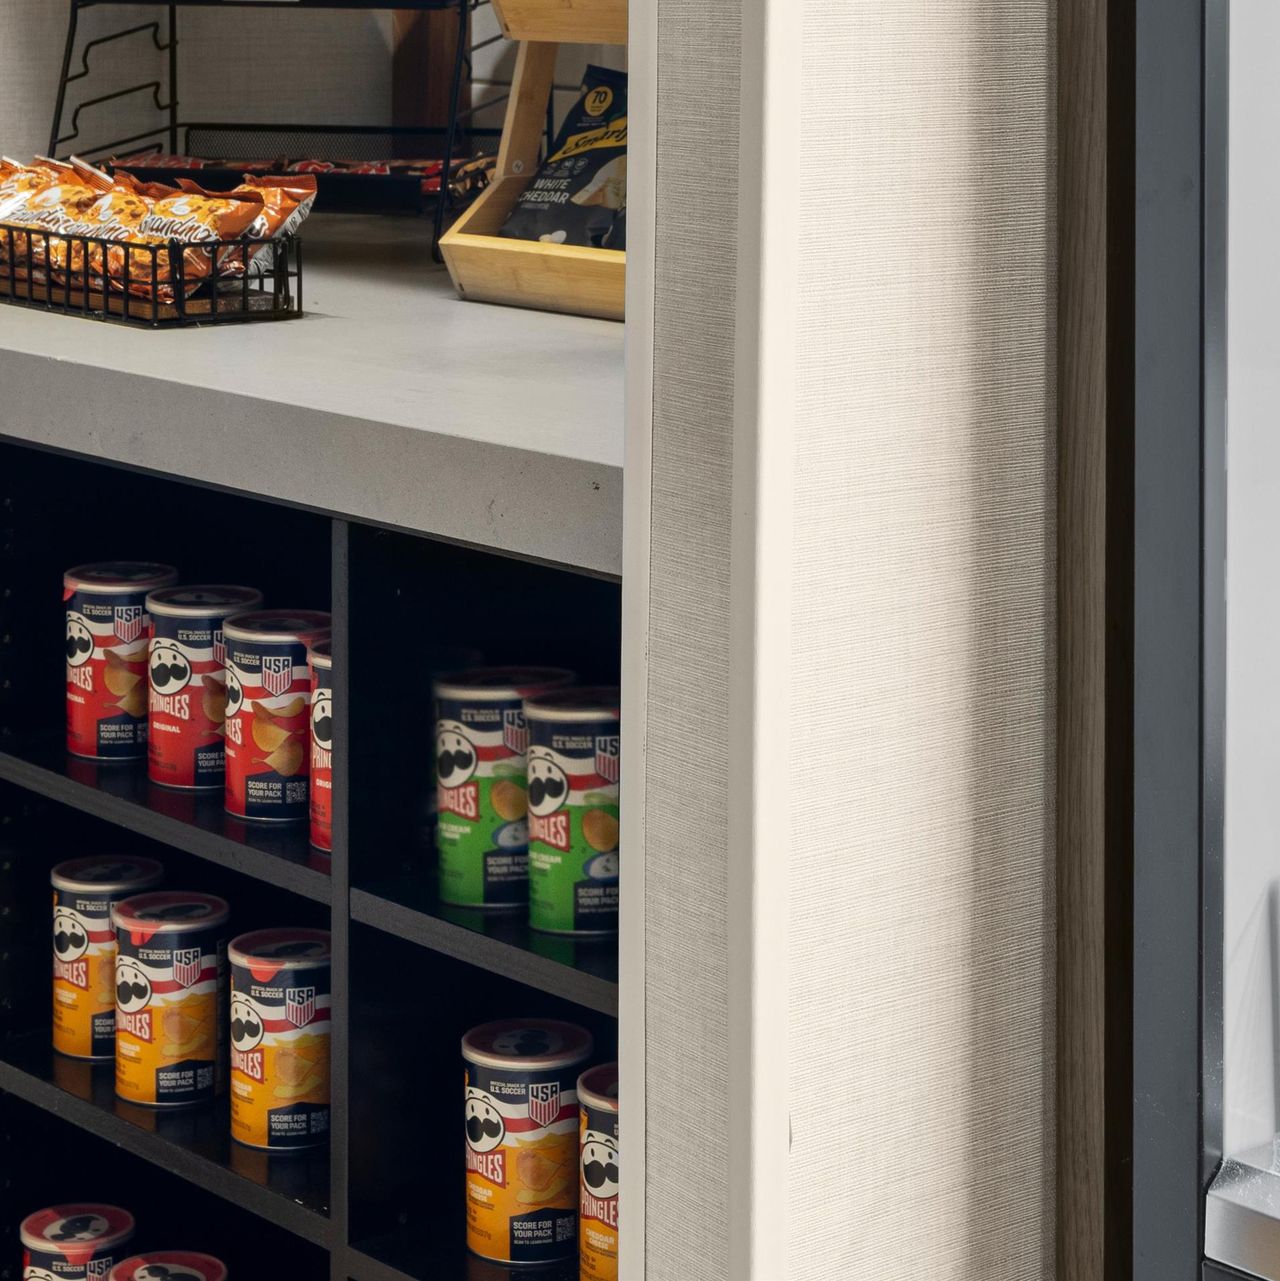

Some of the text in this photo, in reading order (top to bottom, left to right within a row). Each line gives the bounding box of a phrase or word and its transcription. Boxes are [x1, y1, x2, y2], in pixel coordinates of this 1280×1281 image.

[592, 91, 607, 104] 70
[534, 178, 571, 189] WHITE
[519, 191, 570, 204] CHEDDAR
[264, 658, 292, 673] USA
[248, 781, 268, 790] SCORE
[248, 789, 264, 797] YOUR
[175, 951, 200, 965] USA
[288, 989, 314, 1005] USA
[501, 1087, 526, 1095] SOCCER
[531, 1085, 559, 1102] USA
[513, 1221, 552, 1230] SCORE FOR
[513, 1229, 552, 1238] YOUR PACK
